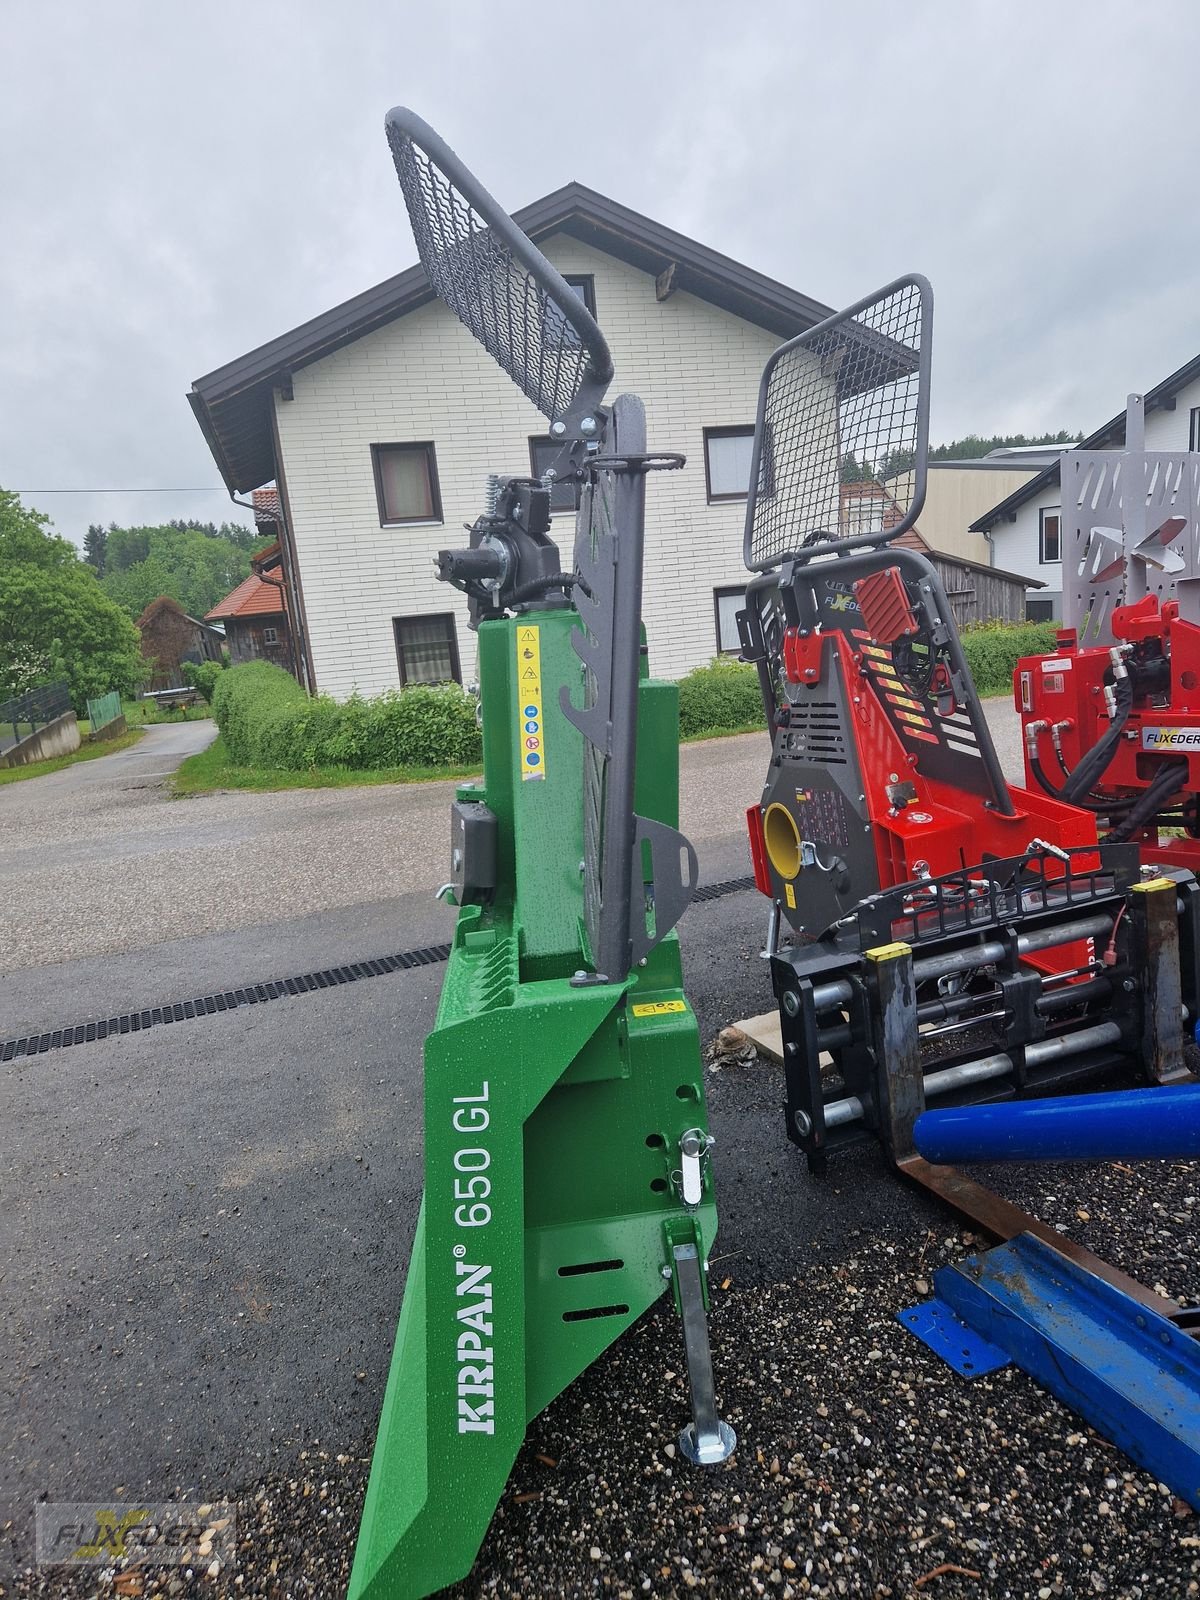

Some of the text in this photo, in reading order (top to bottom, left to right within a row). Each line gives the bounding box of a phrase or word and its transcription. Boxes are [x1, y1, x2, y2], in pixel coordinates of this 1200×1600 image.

[1145, 732, 1200, 745] FLIXEDER
[452, 1080, 490, 1133] GL
[453, 1148, 492, 1227] 650
